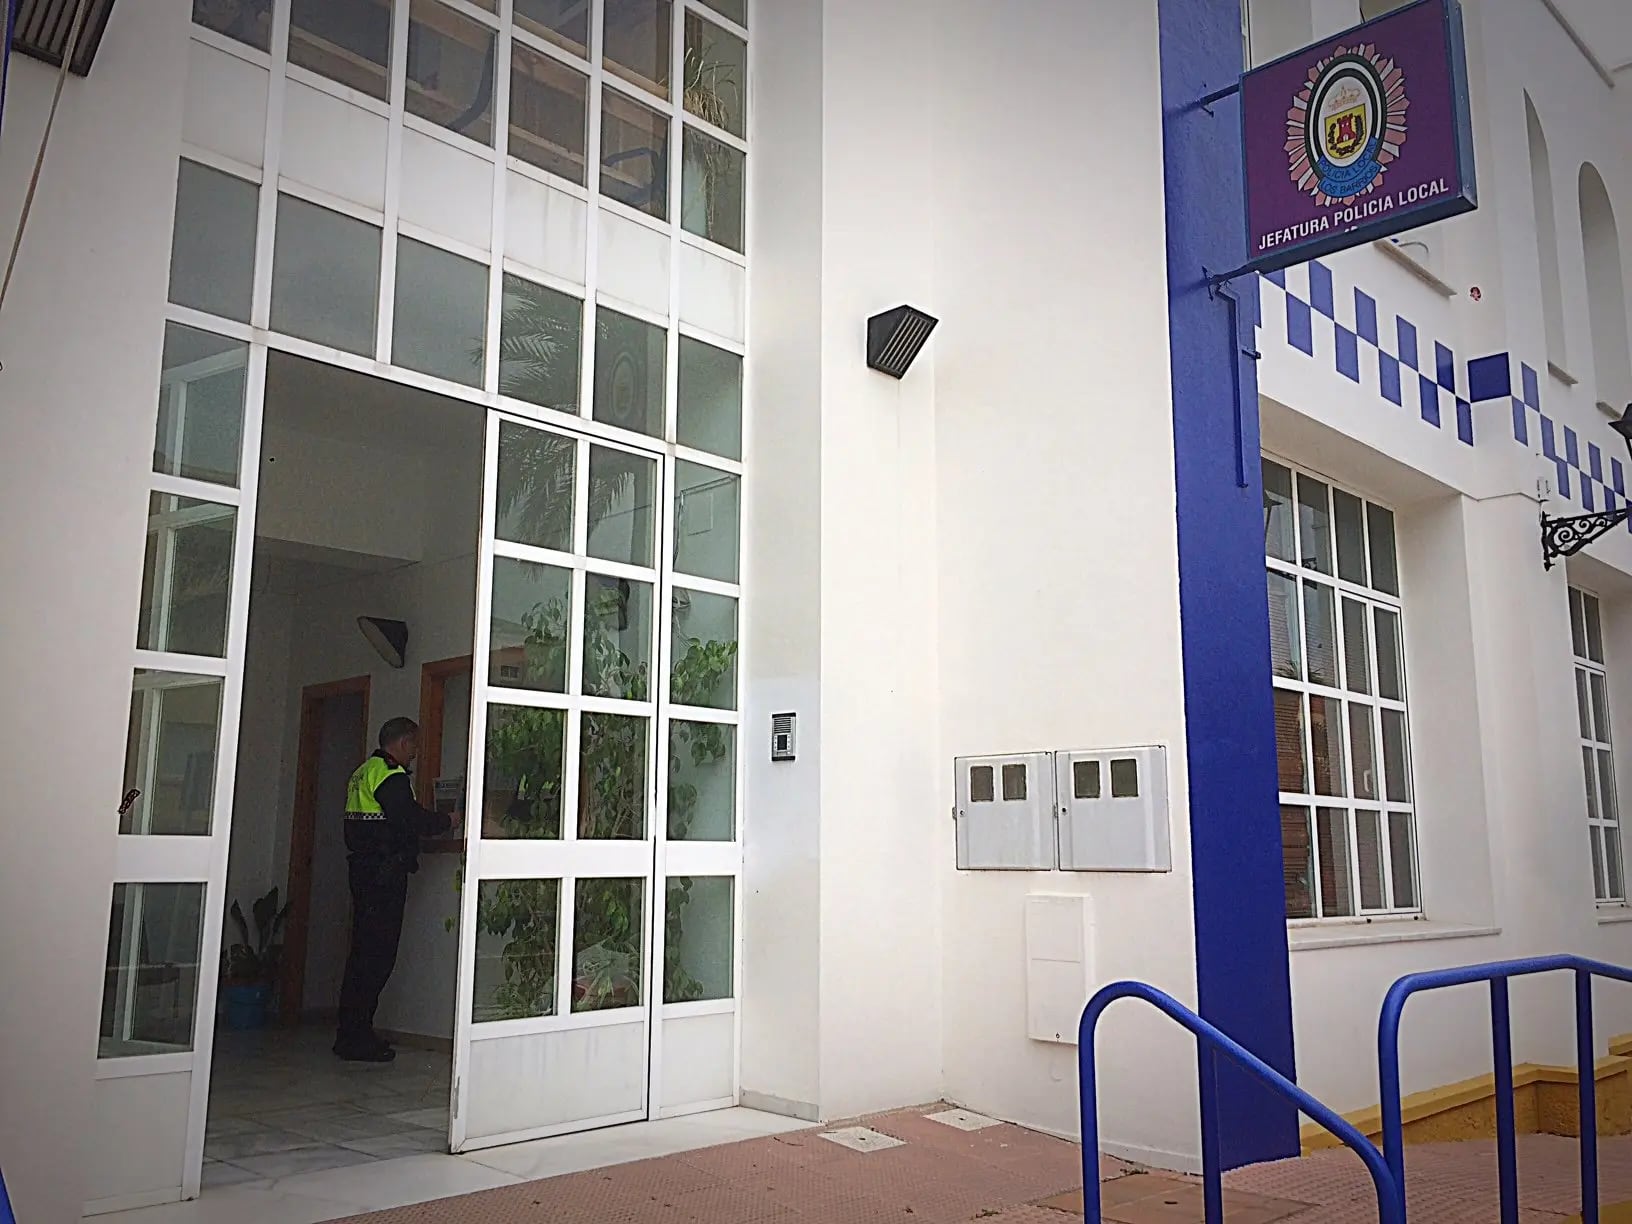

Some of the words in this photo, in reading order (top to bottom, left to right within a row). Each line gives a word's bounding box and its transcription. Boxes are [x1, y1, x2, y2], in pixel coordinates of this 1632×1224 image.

[1319, 159, 1351, 179] POLICIA
[1320, 180, 1337, 194] LOS
[1339, 165, 1377, 192] BARRIOS
[1258, 216, 1329, 250] JEFATURA
[1334, 195, 1393, 226] POLICIA
[1399, 178, 1449, 206] LOCAL
